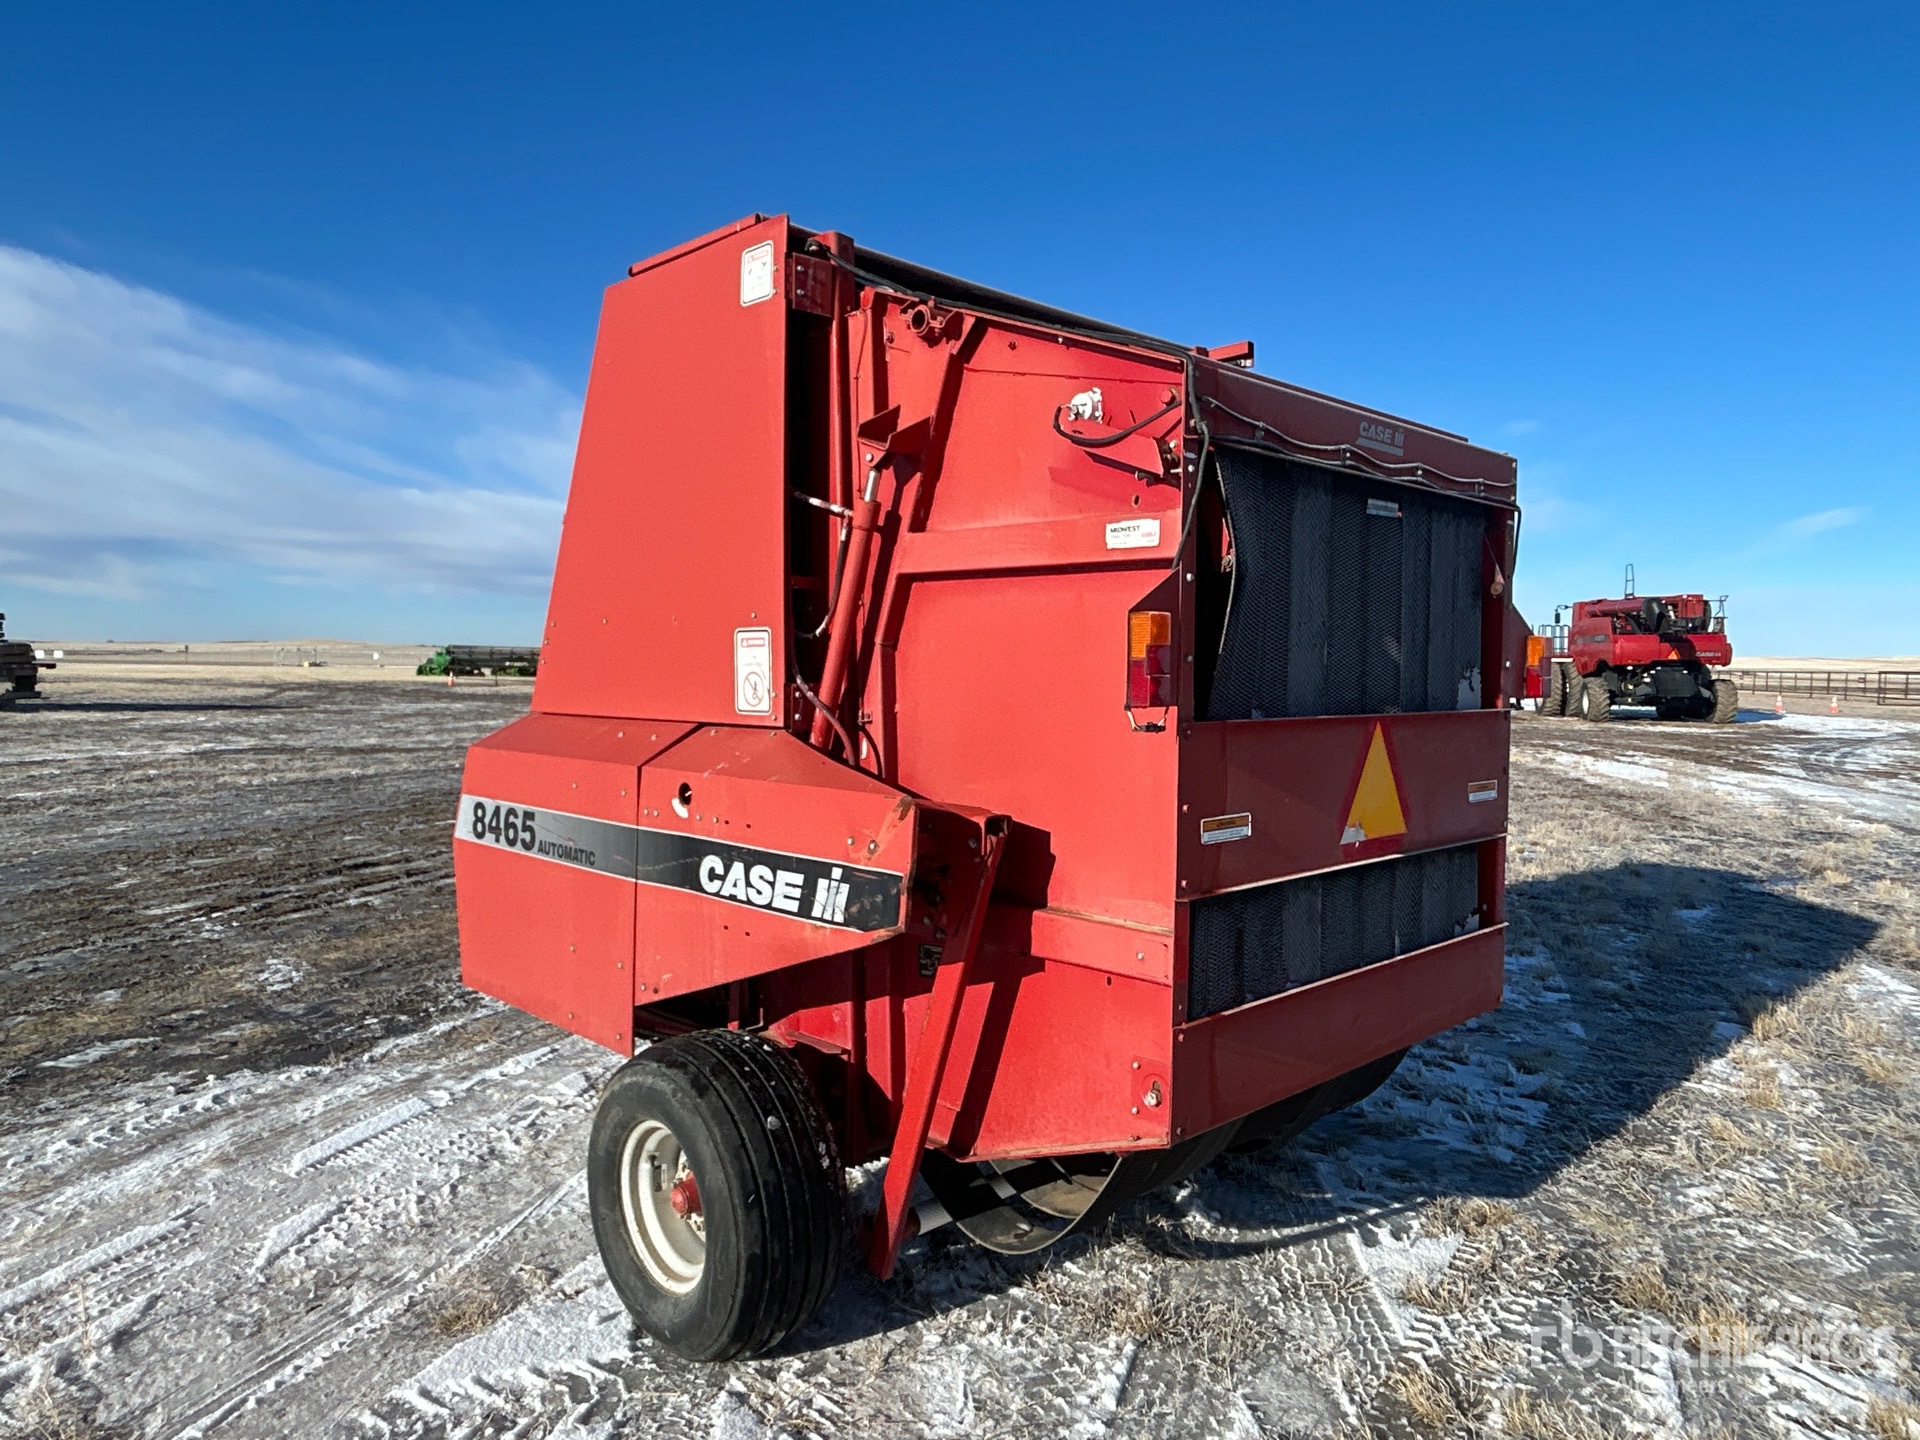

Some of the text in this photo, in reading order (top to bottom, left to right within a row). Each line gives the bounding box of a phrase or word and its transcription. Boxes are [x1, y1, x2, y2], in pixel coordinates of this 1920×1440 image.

[1359, 420, 1393, 444] CASE
[1110, 525, 1141, 533] MIDWEST
[472, 801, 596, 866] 8465 AUTOMATIC
[699, 854, 805, 913] CASE
